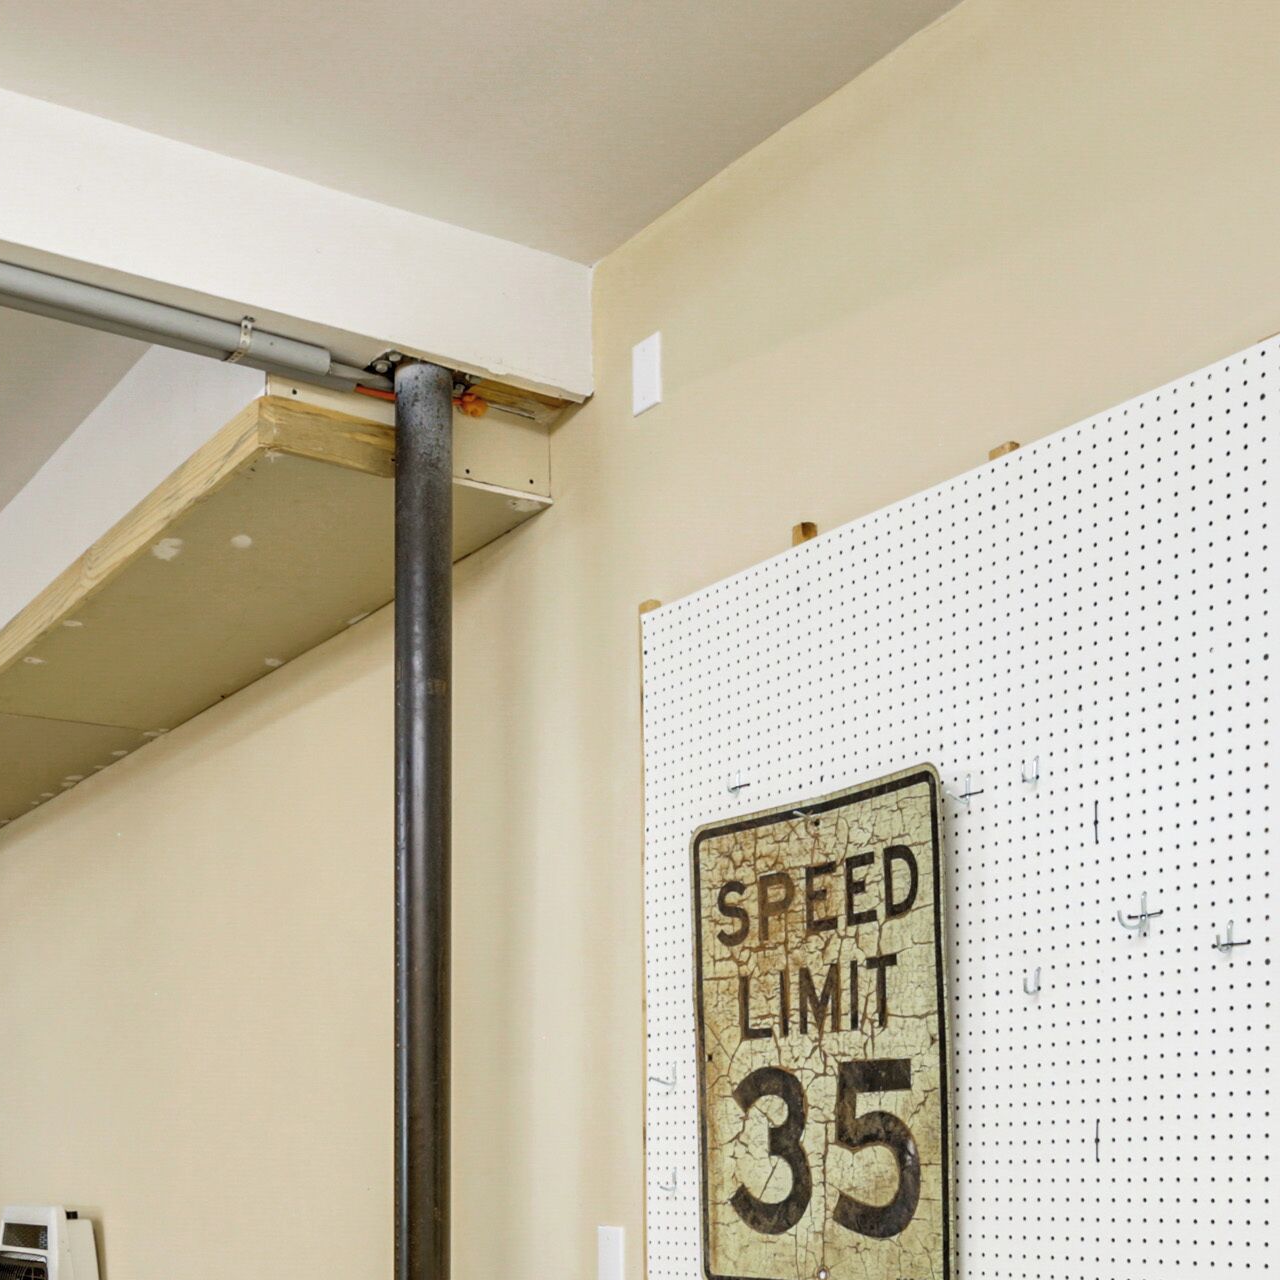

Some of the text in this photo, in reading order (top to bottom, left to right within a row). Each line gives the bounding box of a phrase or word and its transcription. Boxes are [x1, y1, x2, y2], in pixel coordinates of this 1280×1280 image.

[716, 843, 920, 948] SPEED
[738, 953, 898, 1041] LIMIT
[729, 1058, 922, 1239] 35
